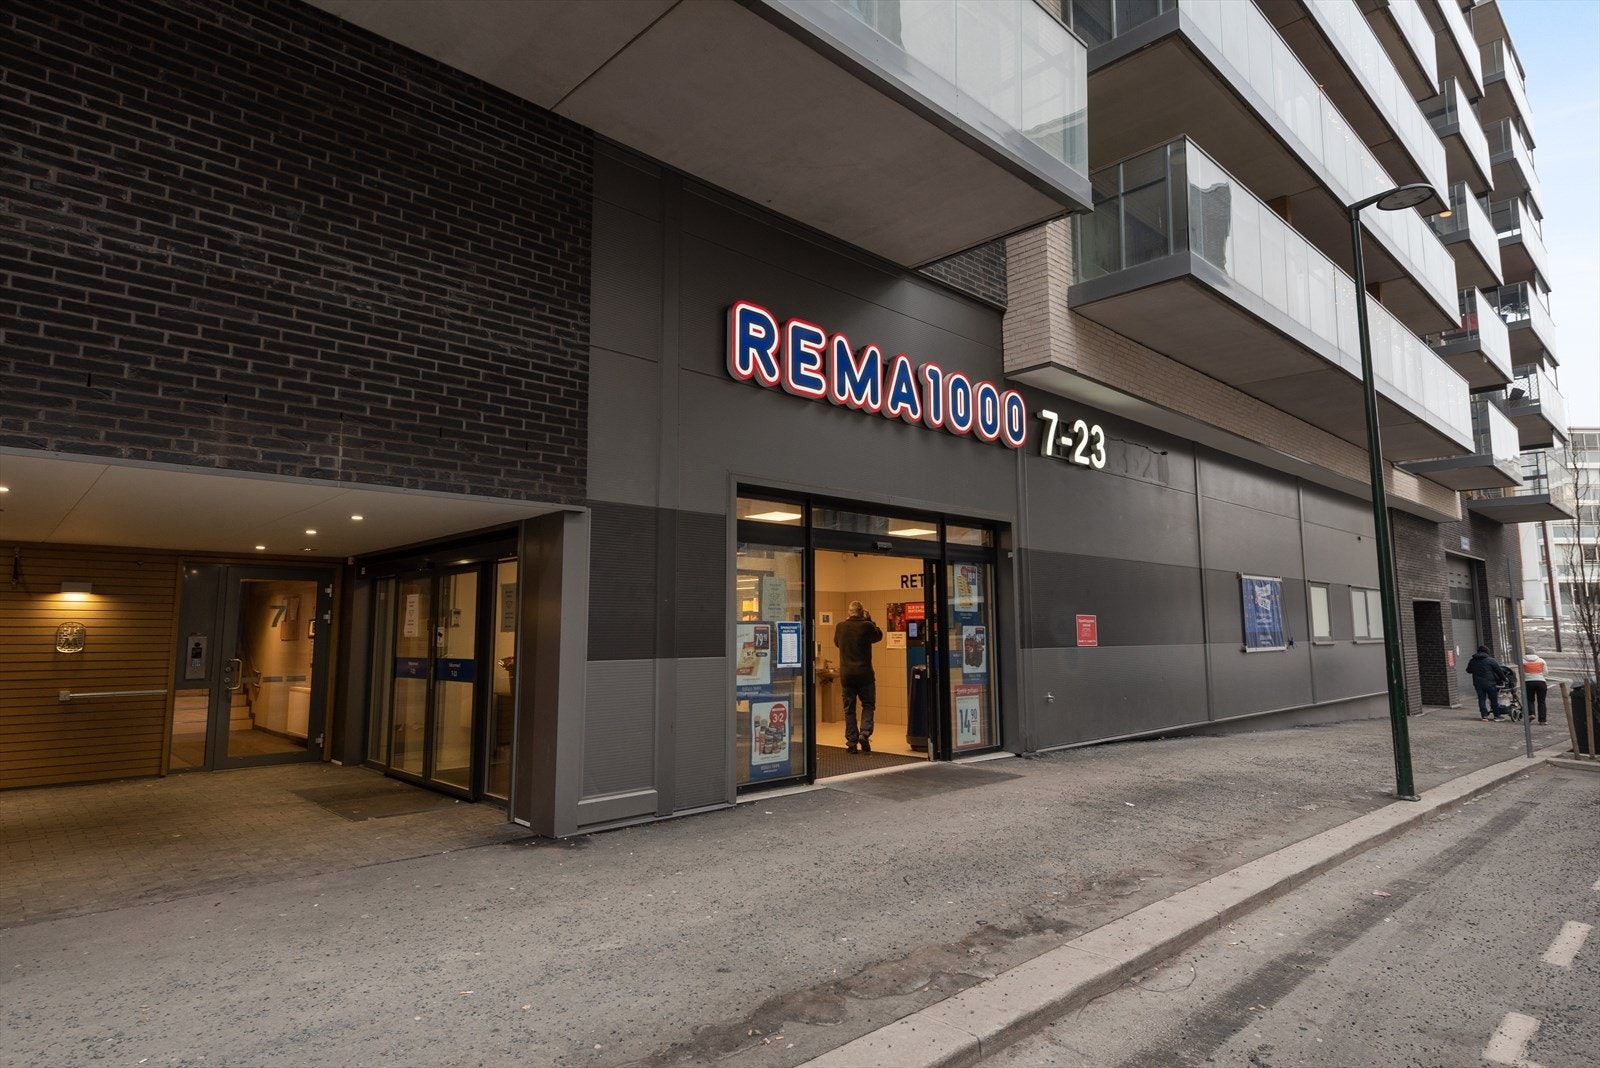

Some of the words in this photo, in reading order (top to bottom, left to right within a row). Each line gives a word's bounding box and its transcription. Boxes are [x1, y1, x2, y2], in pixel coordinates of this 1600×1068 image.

[1042, 409, 1106, 469] 7-23
[901, 573, 926, 589] RET
[270, 605, 288, 628] 7
